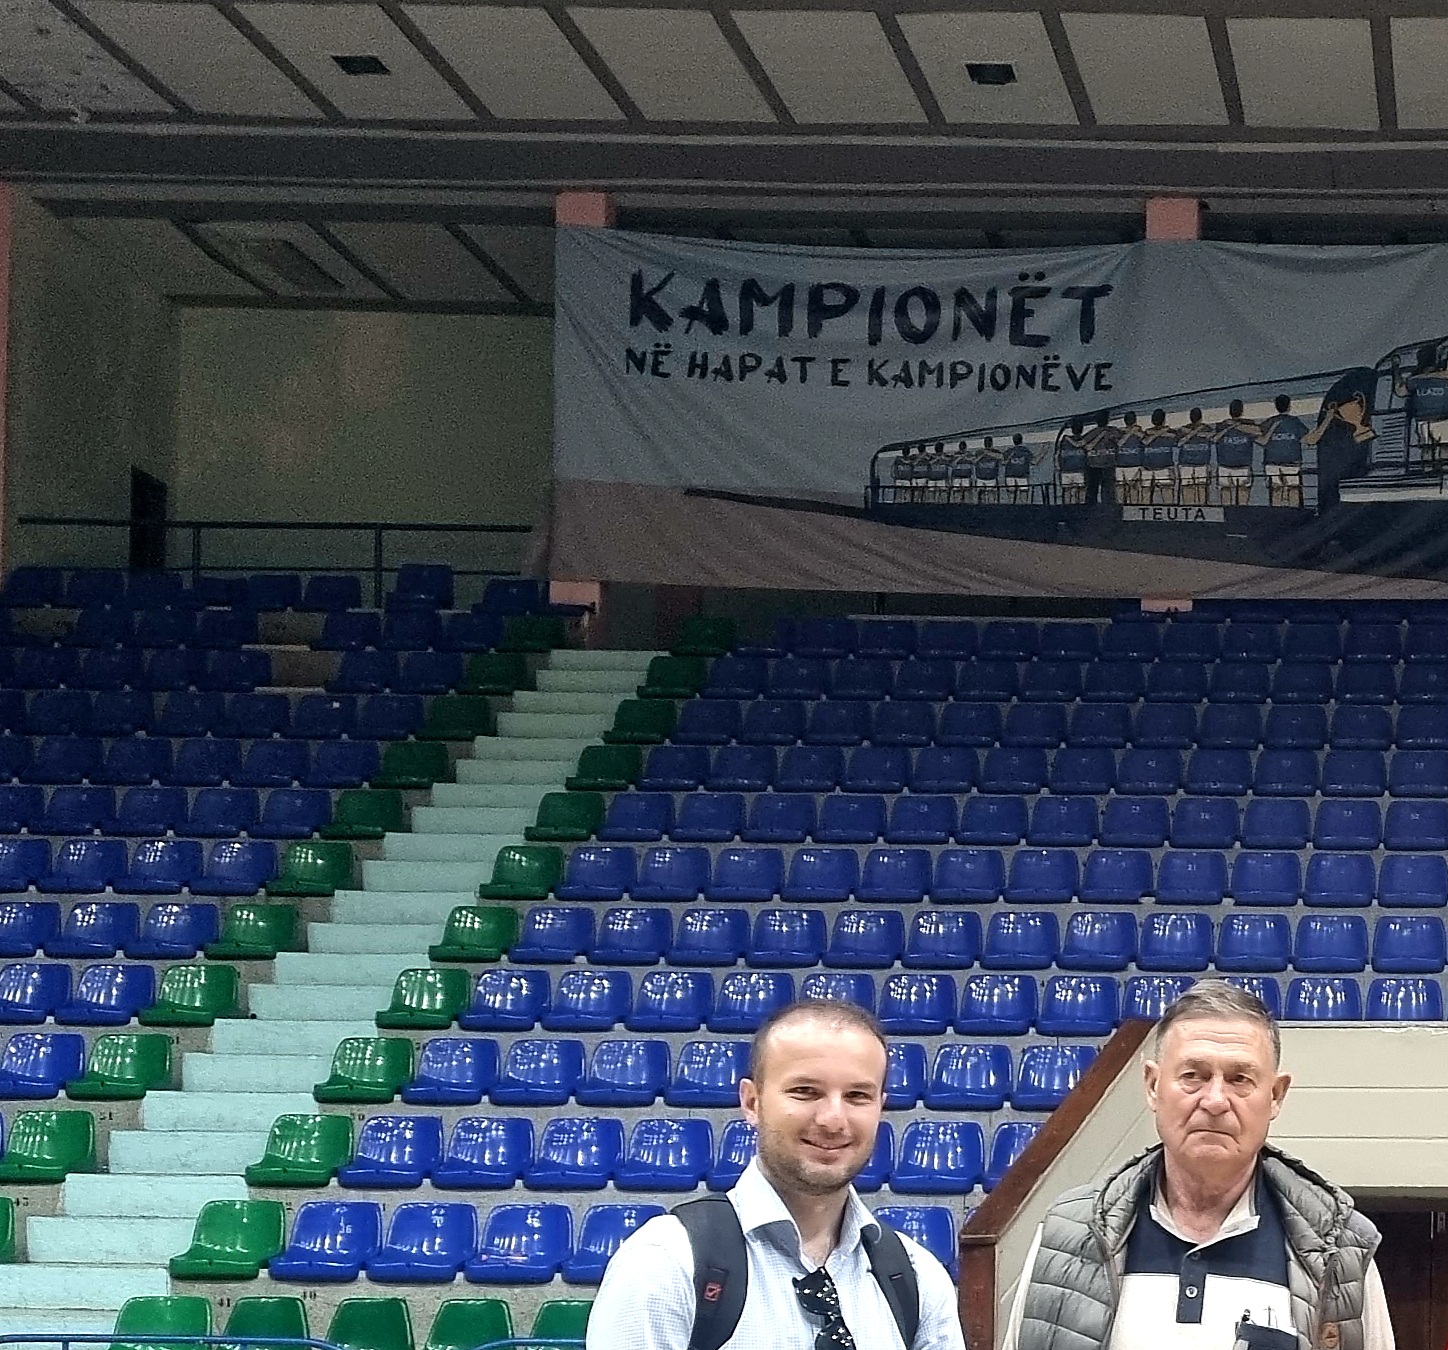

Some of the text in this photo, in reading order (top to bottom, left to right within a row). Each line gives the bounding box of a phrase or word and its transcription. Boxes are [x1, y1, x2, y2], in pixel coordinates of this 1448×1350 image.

[628, 269, 1114, 348] KAMPIONËT
[624, 342, 1114, 394] NË HAPAT E KAMPIONËVE
[1138, 507, 1206, 521] TEUTA
